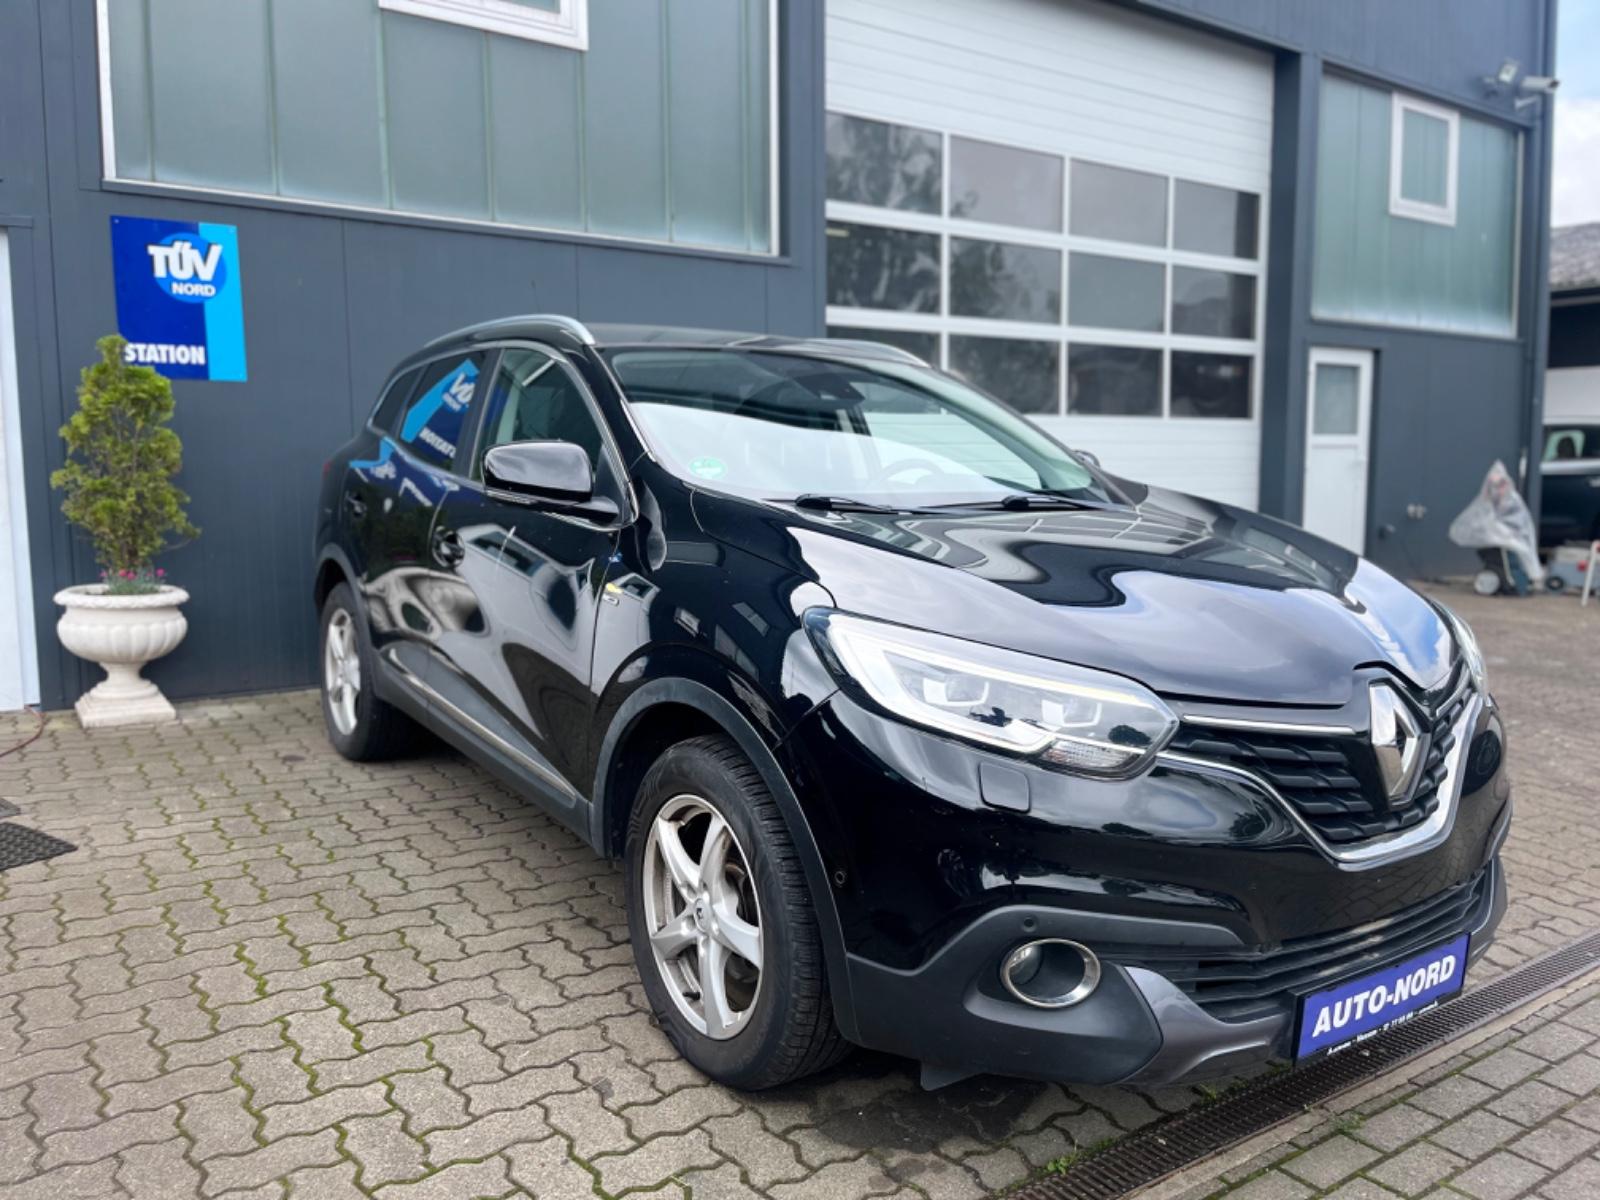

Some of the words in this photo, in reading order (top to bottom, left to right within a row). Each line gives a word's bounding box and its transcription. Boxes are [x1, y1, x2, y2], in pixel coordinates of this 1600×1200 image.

[147, 240, 223, 281] TÜV
[171, 282, 216, 297] NORD
[124, 342, 206, 365] STATION
[1312, 955, 1456, 1038] AUTO-NORD
